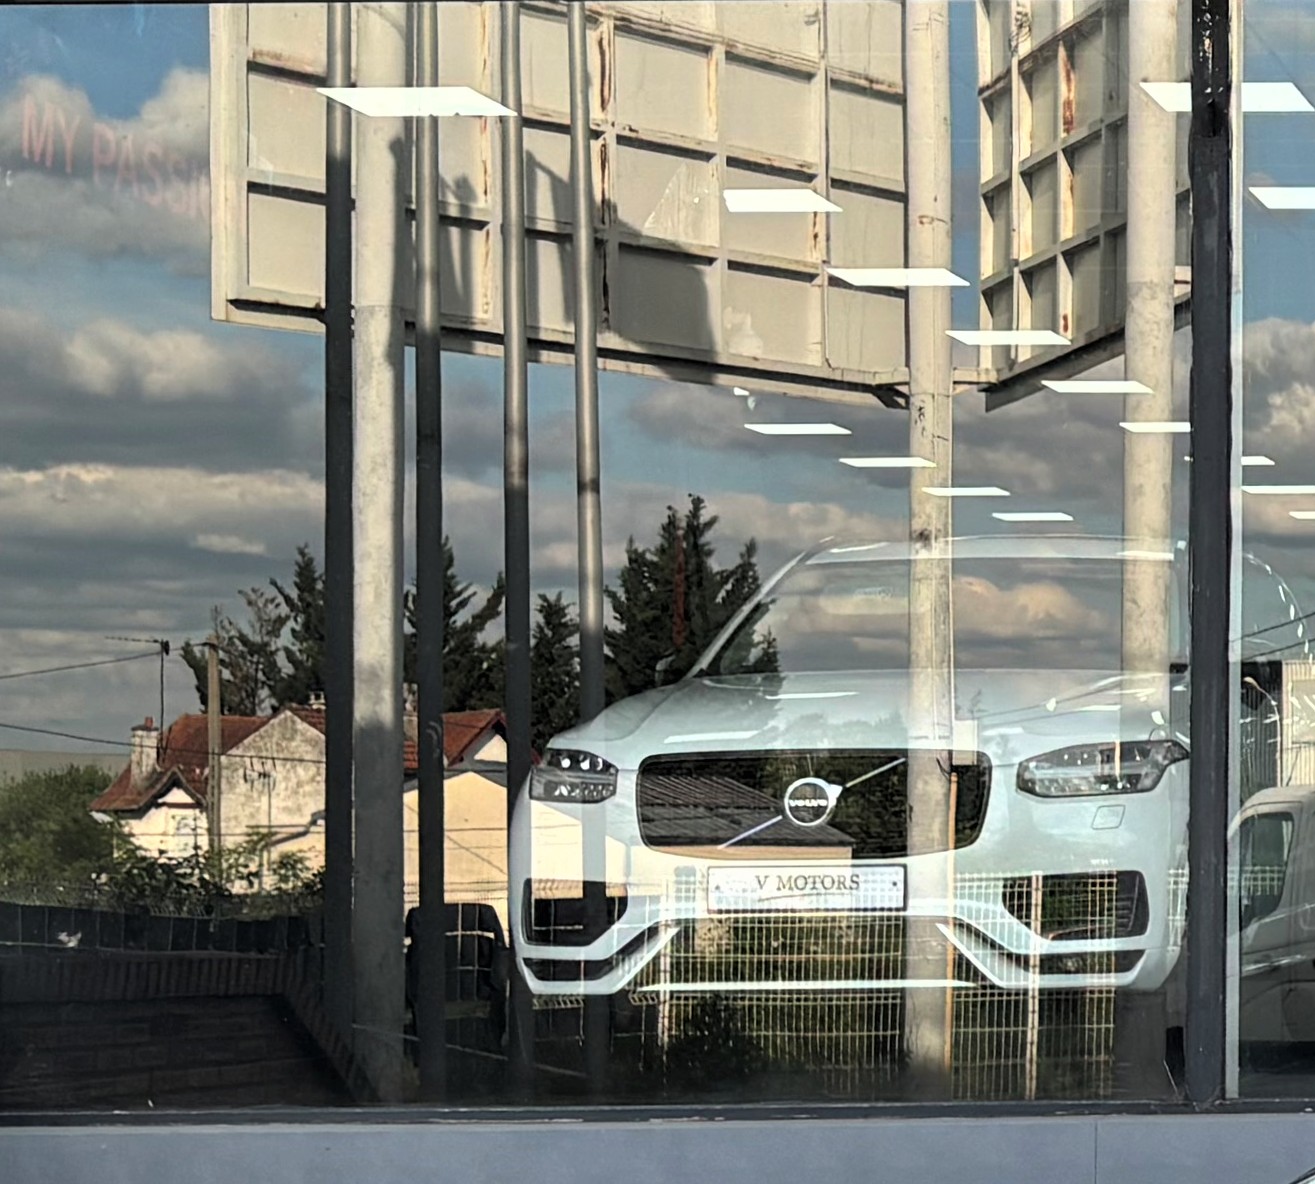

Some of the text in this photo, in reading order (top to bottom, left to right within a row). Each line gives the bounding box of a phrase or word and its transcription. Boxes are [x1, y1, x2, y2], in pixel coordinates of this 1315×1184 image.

[788, 799, 828, 807] VOLVO
[755, 874, 861, 891] V MOTORS
